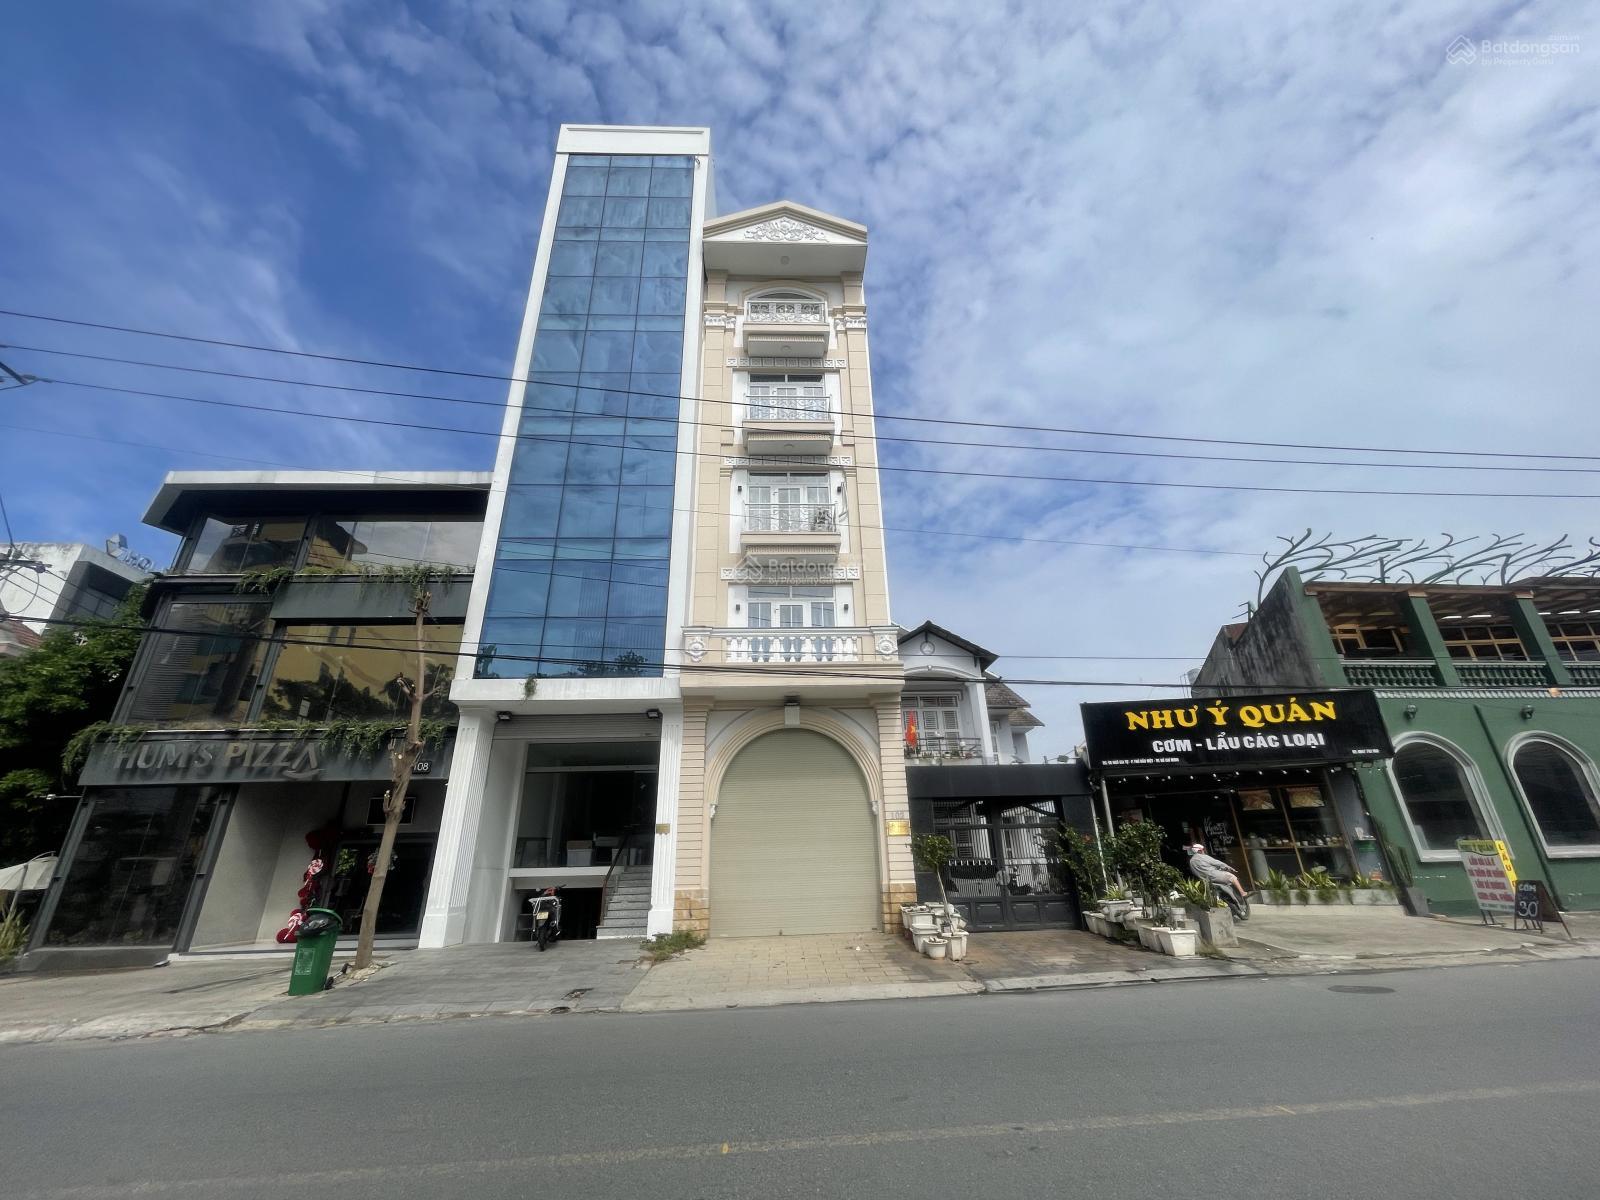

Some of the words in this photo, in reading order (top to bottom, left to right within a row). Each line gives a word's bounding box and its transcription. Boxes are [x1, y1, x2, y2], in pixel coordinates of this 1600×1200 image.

[1125, 705, 1198, 730] NHƯ
[1206, 700, 1230, 726] Ý
[1239, 697, 1337, 728] QUÁN
[113, 743, 213, 769] HUM'S
[225, 742, 320, 770] PIZZA
[1152, 738, 1193, 753] CƠM
[1206, 731, 1241, 751] LẨU
[1243, 733, 1280, 749] CÁC
[1282, 733, 1326, 749] LOẠI
